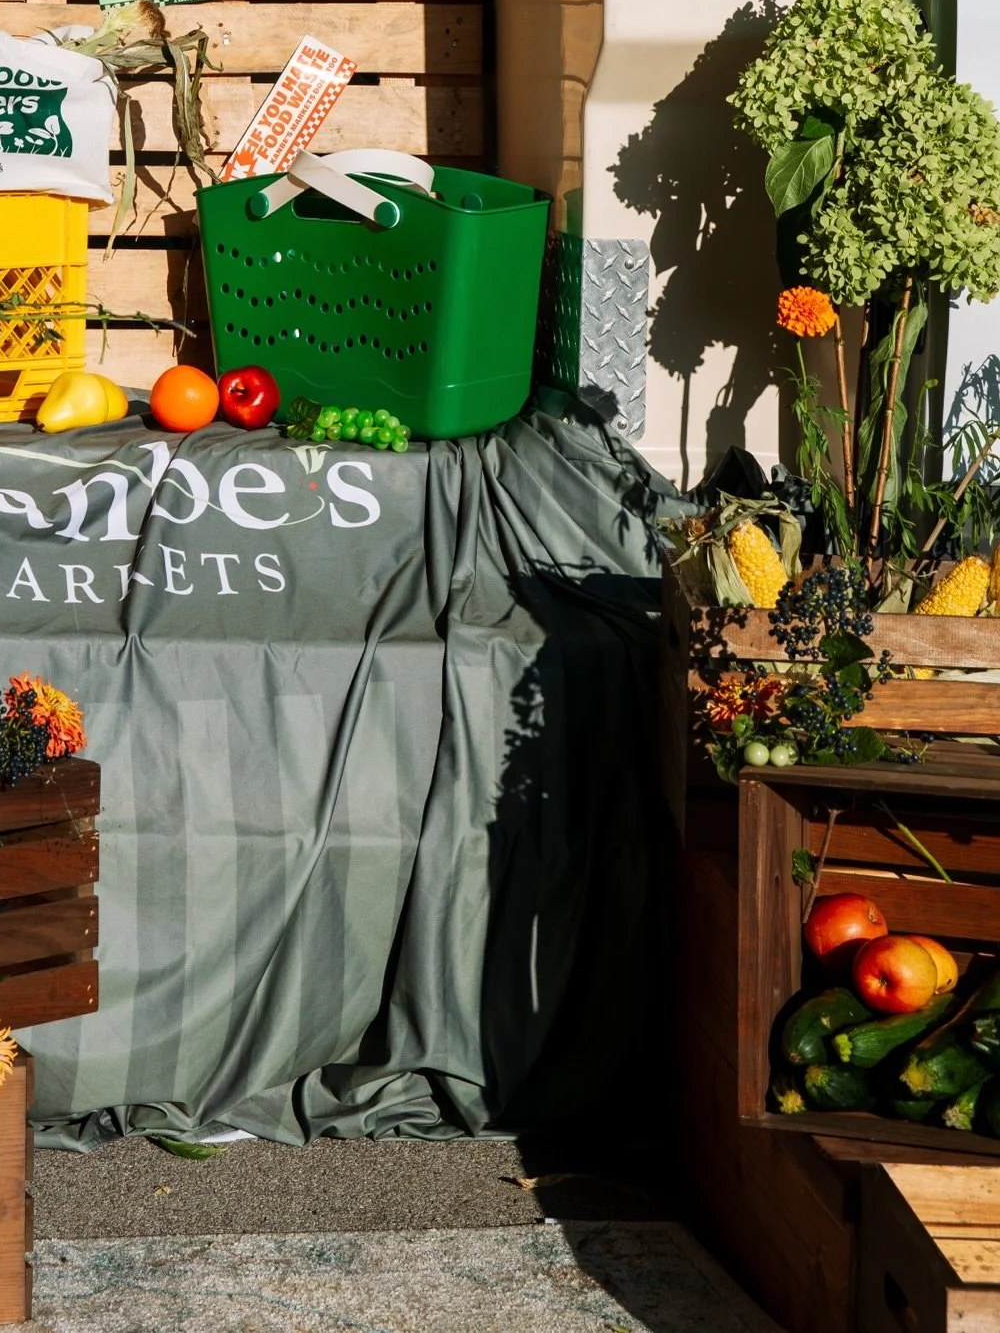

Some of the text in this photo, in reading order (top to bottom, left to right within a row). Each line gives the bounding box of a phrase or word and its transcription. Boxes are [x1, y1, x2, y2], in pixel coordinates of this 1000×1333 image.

[246, 129, 266, 150] IF
[258, 91, 288, 128] YOU
[257, 109, 294, 159] FOOD
[269, 131, 293, 165] KANBE'S
[292, 94, 316, 130] MARKETS
